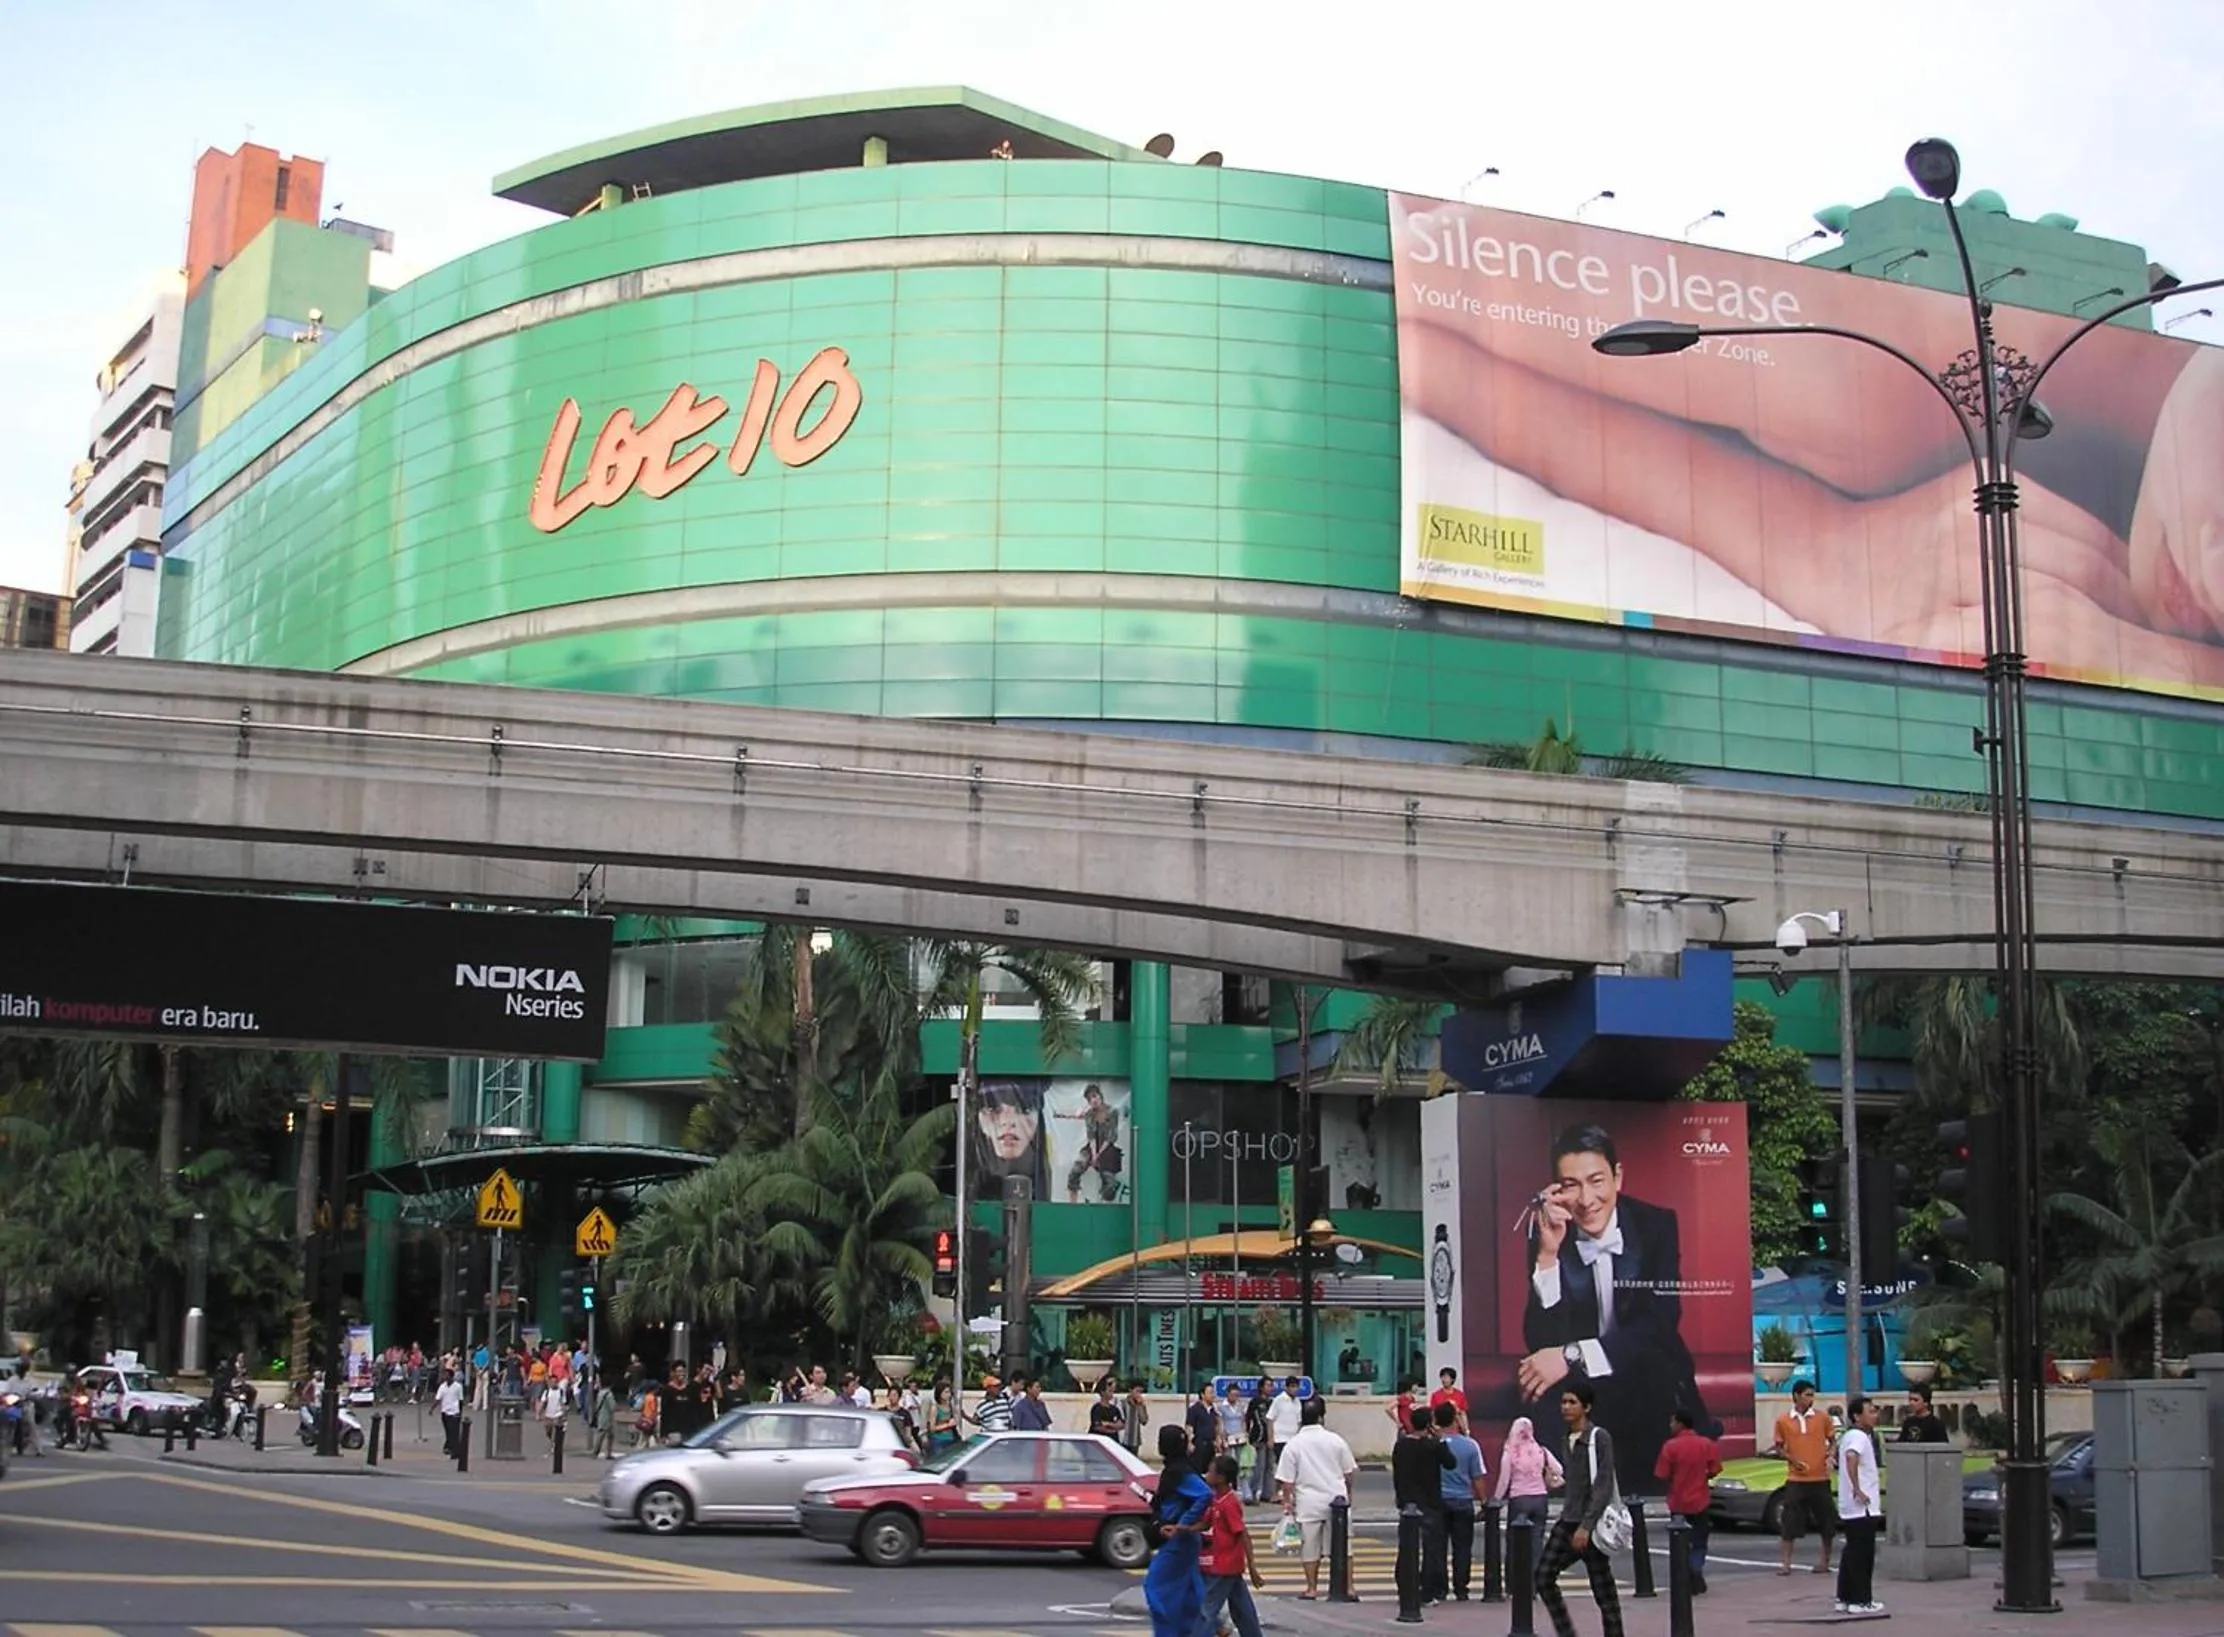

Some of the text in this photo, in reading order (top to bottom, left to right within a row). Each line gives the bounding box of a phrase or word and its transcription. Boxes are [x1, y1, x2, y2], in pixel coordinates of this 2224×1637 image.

[1408, 211, 1610, 294] Silence
[1412, 282, 1482, 314] You're
[1487, 302, 1581, 338] entering
[1718, 337, 1776, 367] Zone.
[530, 347, 862, 533] Lot 10
[1429, 514, 1534, 554] STARHILL
[456, 963, 585, 993] NOKIA
[44, 996, 155, 1029] komputer
[161, 1008, 197, 1027] era
[202, 1005, 260, 1031] baru.
[505, 992, 585, 1019] Nseries
[1484, 1033, 1545, 1067] CYMA
[1682, 1142, 1731, 1154] CYMA
[1155, 1344, 1174, 1390] SAITS
